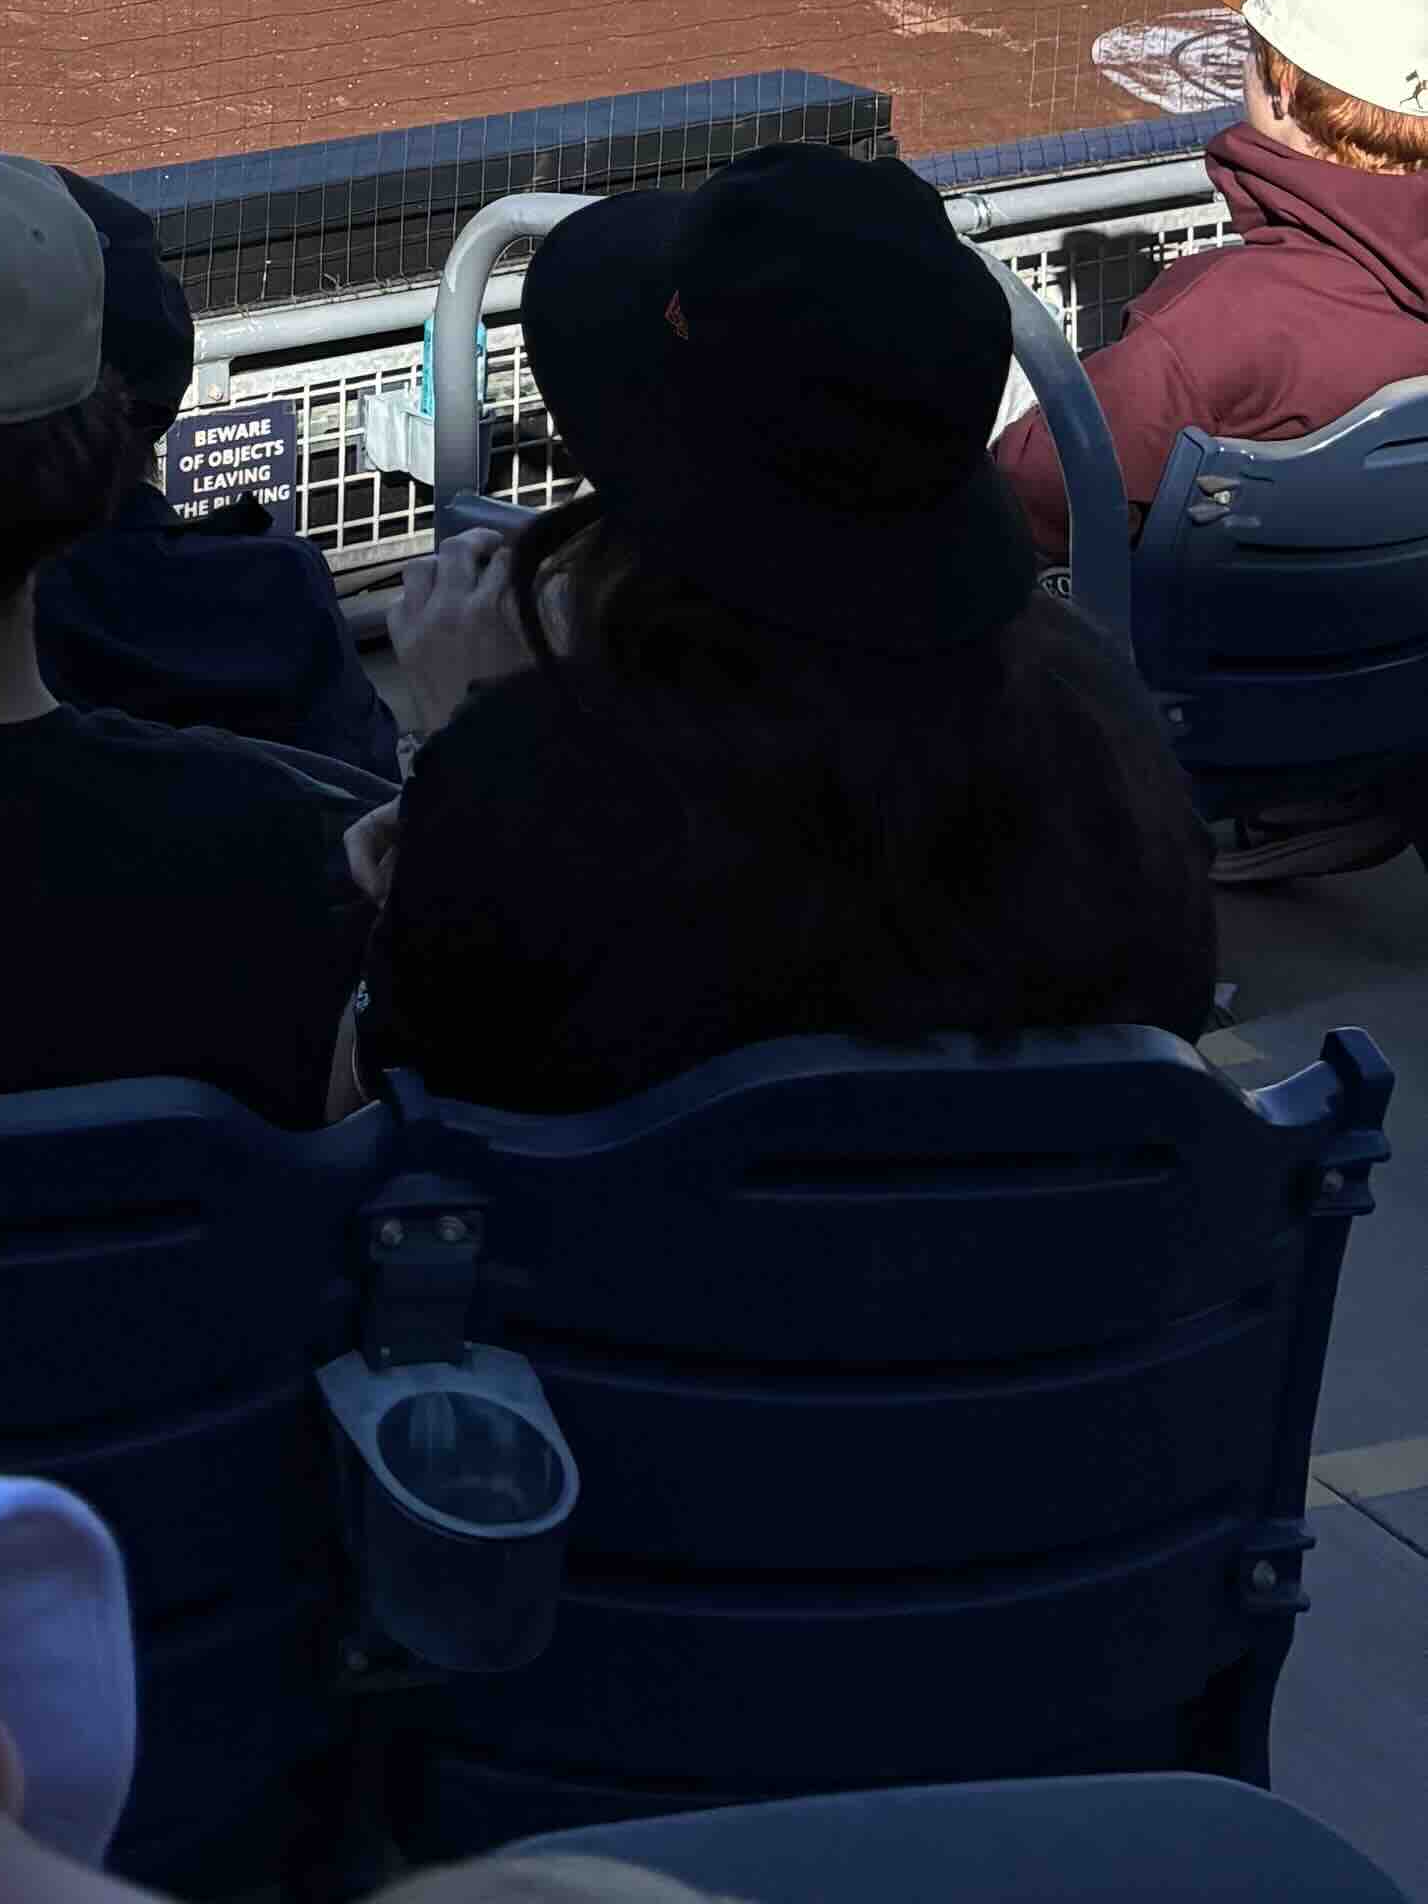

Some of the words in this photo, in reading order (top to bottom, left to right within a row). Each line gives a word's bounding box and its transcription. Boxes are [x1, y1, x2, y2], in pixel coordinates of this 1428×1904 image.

[194, 418, 272, 447] BEWARE
[179, 454, 205, 473] OF
[208, 440, 285, 468] OBJECTS
[193, 464, 272, 494] LEAVING
[172, 500, 210, 520] THE
